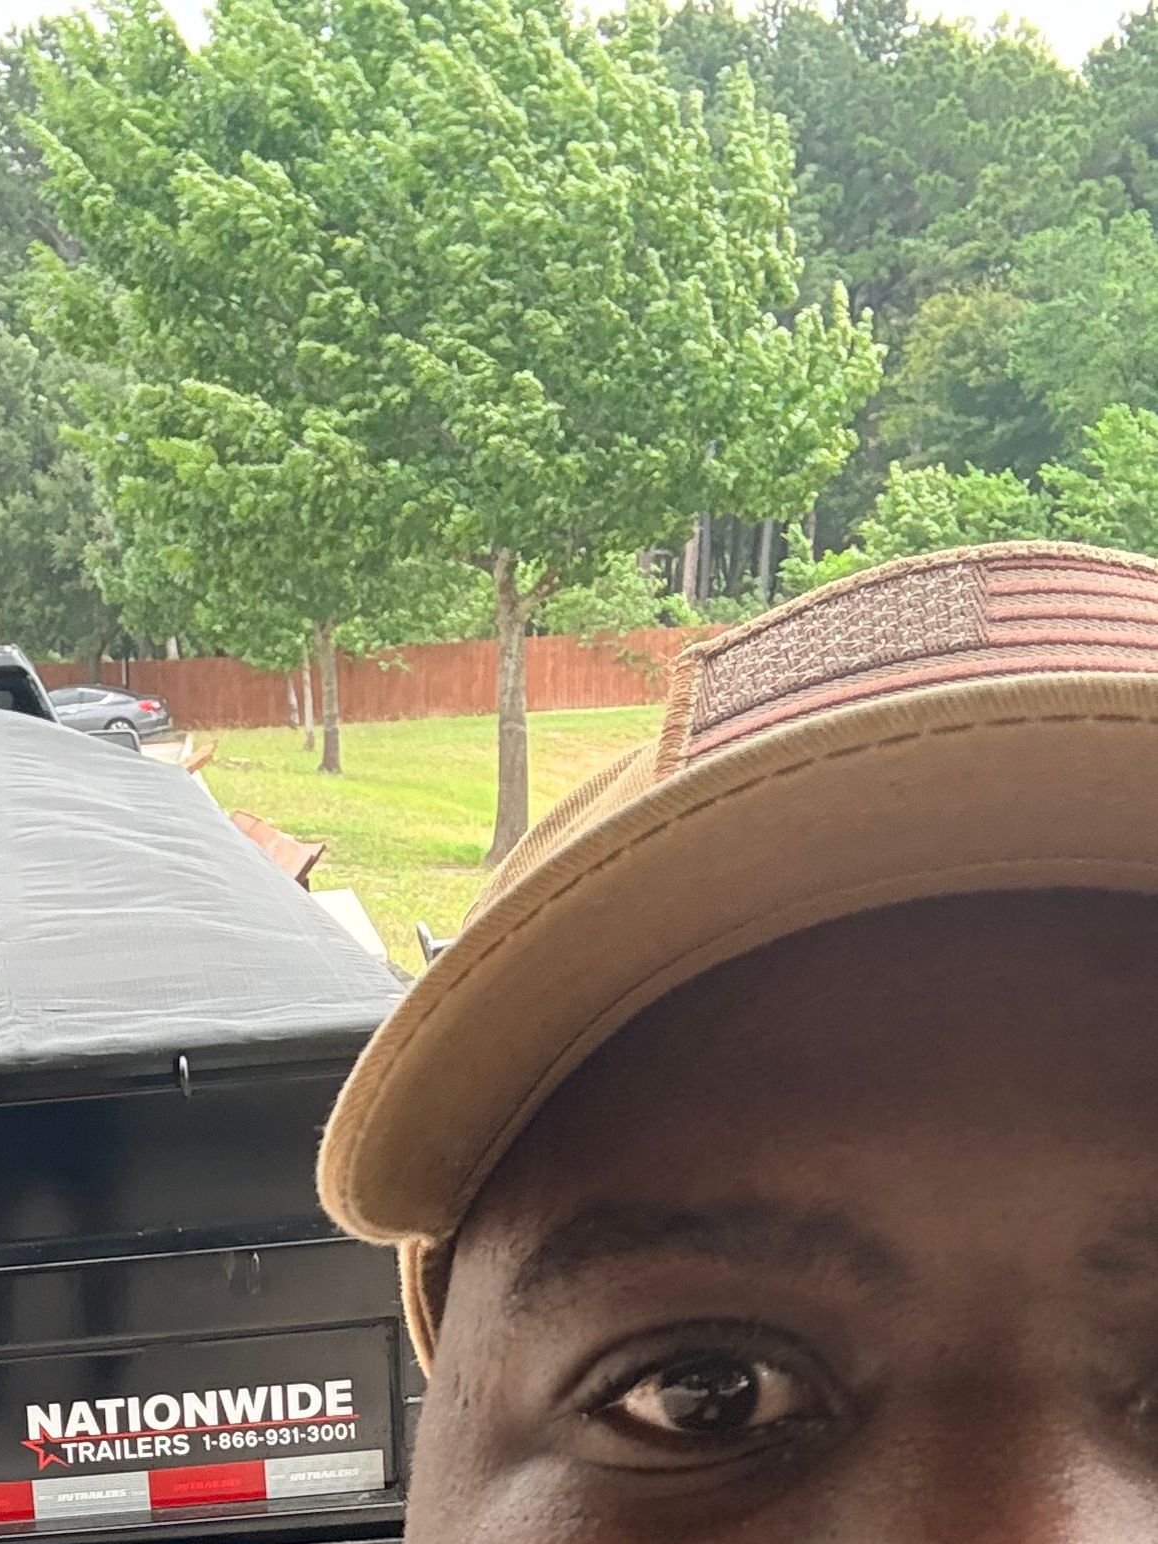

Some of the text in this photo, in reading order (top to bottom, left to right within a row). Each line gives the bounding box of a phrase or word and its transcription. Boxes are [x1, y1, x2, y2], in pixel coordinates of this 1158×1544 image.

[26, 1379, 354, 1440] NATIONWIDE
[61, 1422, 357, 1464] TRAILERS 1-866-931-3001
